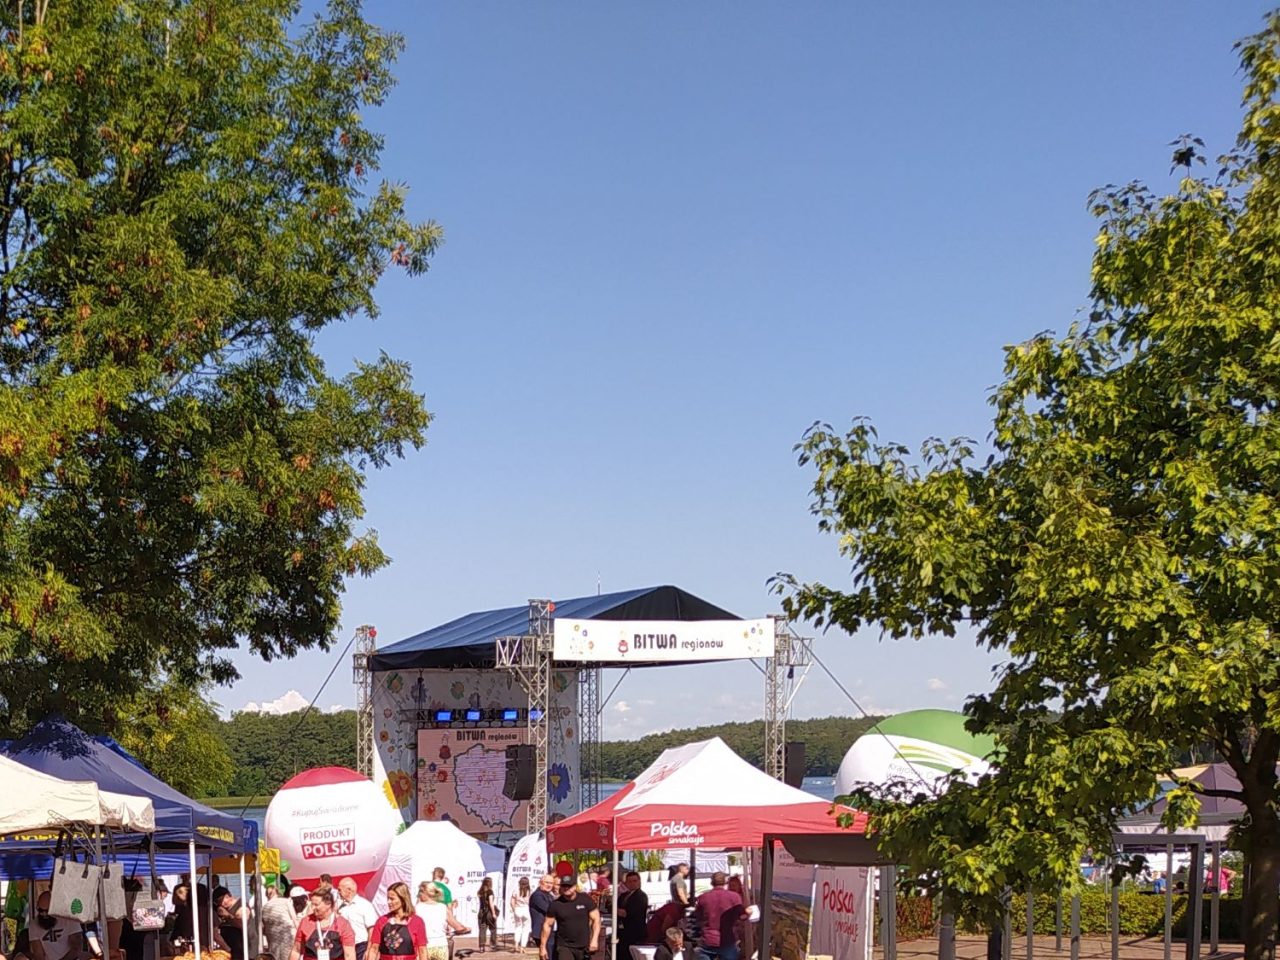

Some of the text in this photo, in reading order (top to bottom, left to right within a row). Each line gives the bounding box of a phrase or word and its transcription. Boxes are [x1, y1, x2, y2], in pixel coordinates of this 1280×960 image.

[633, 633, 677, 649] BITWA
[456, 730, 486, 741] BITWA
[303, 827, 351, 841] PRODUKT
[650, 820, 698, 837] Polska
[668, 835, 705, 846] smakuje
[304, 841, 354, 858] POLSKI
[822, 880, 855, 915] Polska
